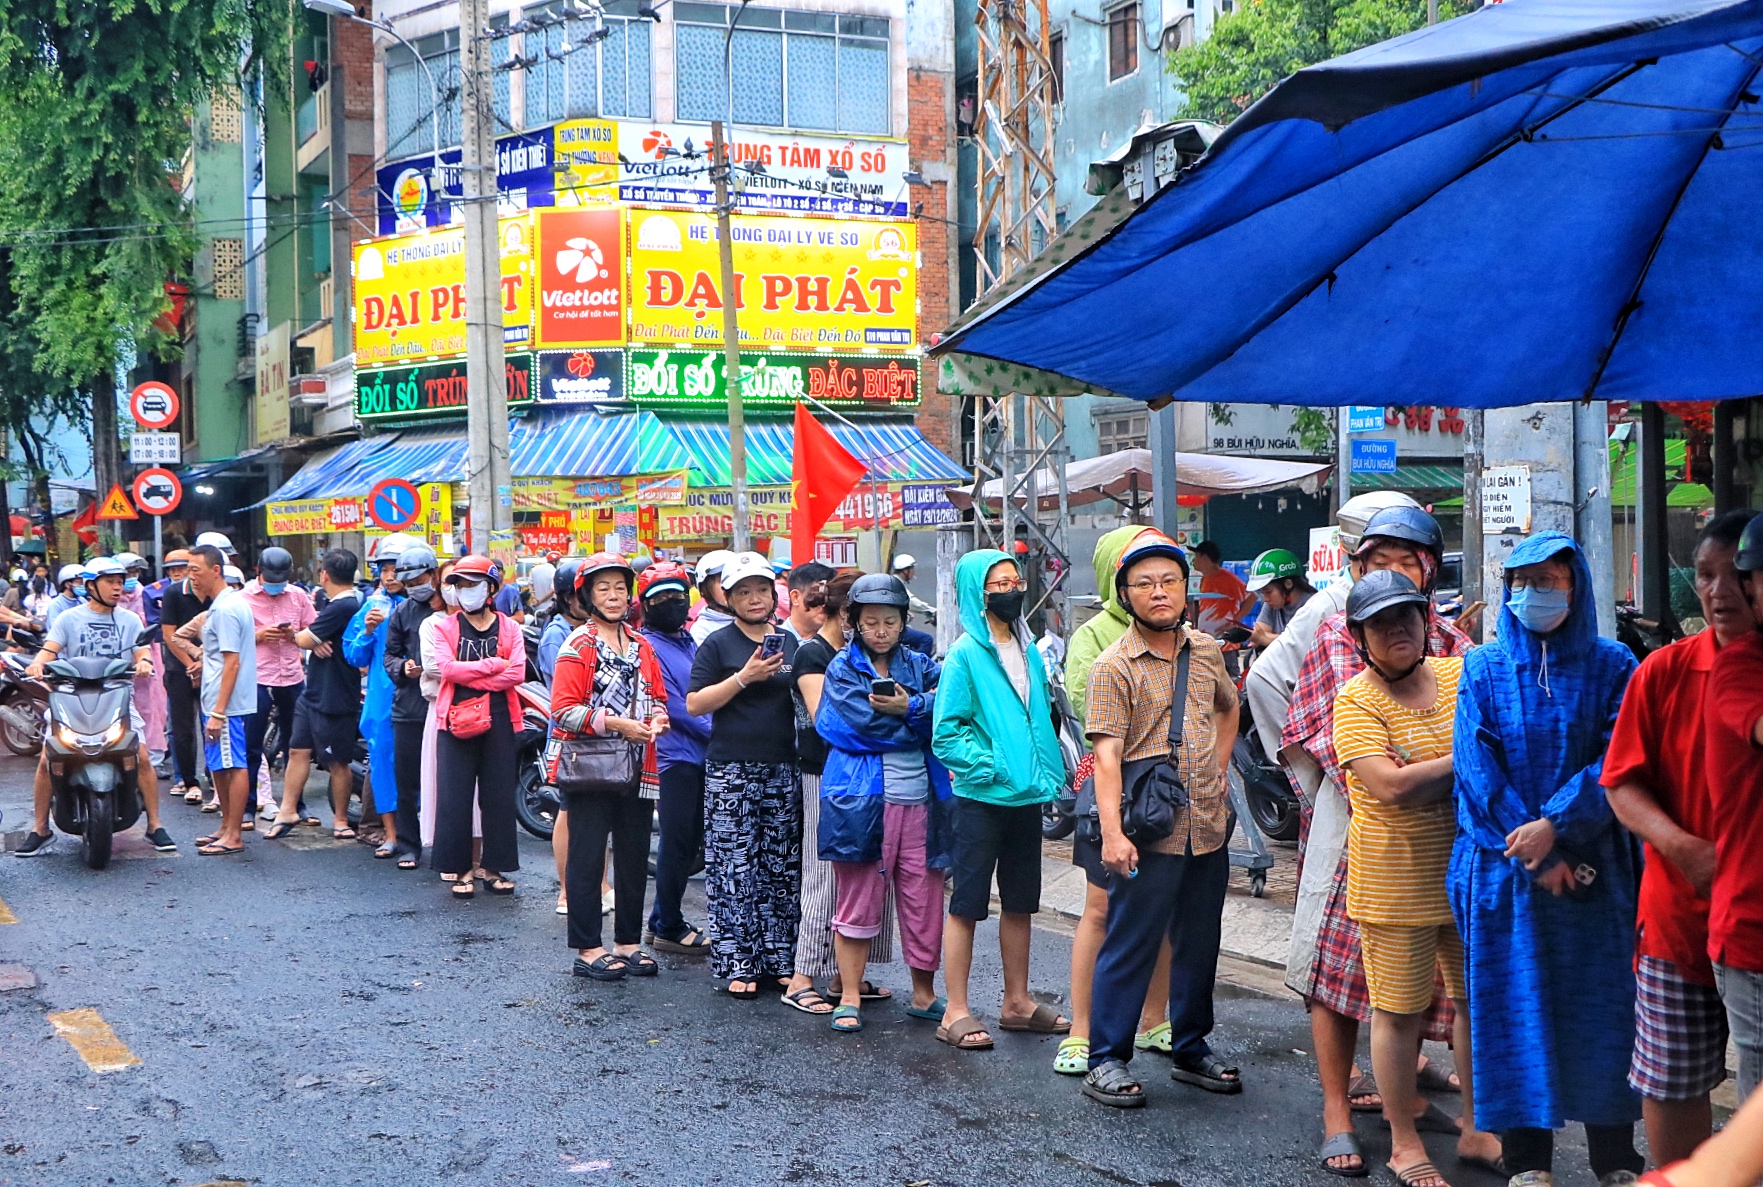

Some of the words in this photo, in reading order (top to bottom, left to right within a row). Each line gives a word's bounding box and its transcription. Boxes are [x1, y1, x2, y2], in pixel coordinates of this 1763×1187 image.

[778, 142, 821, 169] TÂM
[828, 141, 855, 171] XỔ
[860, 145, 886, 173] SỐ
[542, 288, 619, 307] Vietlott
[646, 269, 745, 319] ĐẠI
[762, 267, 902, 314] PHÁT
[364, 290, 420, 338] ĐẠI
[430, 274, 522, 322] PHT
[635, 323, 657, 340] Đại
[661, 323, 690, 338] Phát
[694, 323, 718, 339] Đến
[763, 326, 787, 342] Đặc
[790, 327, 814, 344] Biệt
[818, 327, 841, 342] Đến
[845, 329, 861, 343] Đó
[632, 350, 679, 395] ĐỔI
[684, 351, 716, 396] SỐ
[808, 359, 857, 400] ĐẶC
[863, 360, 916, 402] BIỆT
[360, 371, 391, 414] ĐỔI
[396, 368, 418, 411] SỐ
[1350, 418, 1364, 429] PHAN
[1213, 438, 1224, 448] 98
[1227, 435, 1242, 448] BÙI
[1245, 435, 1265, 449] HỮU
[1361, 443, 1388, 453] ĐƯỜNG
[1352, 457, 1363, 469] BÙI
[752, 490, 775, 506] QUÝ
[666, 511, 734, 535] TRÚNG
[1492, 515, 1514, 524] NGƯỜI
[1279, 562, 1296, 572] Grab
[1312, 542, 1334, 572] SỮA
